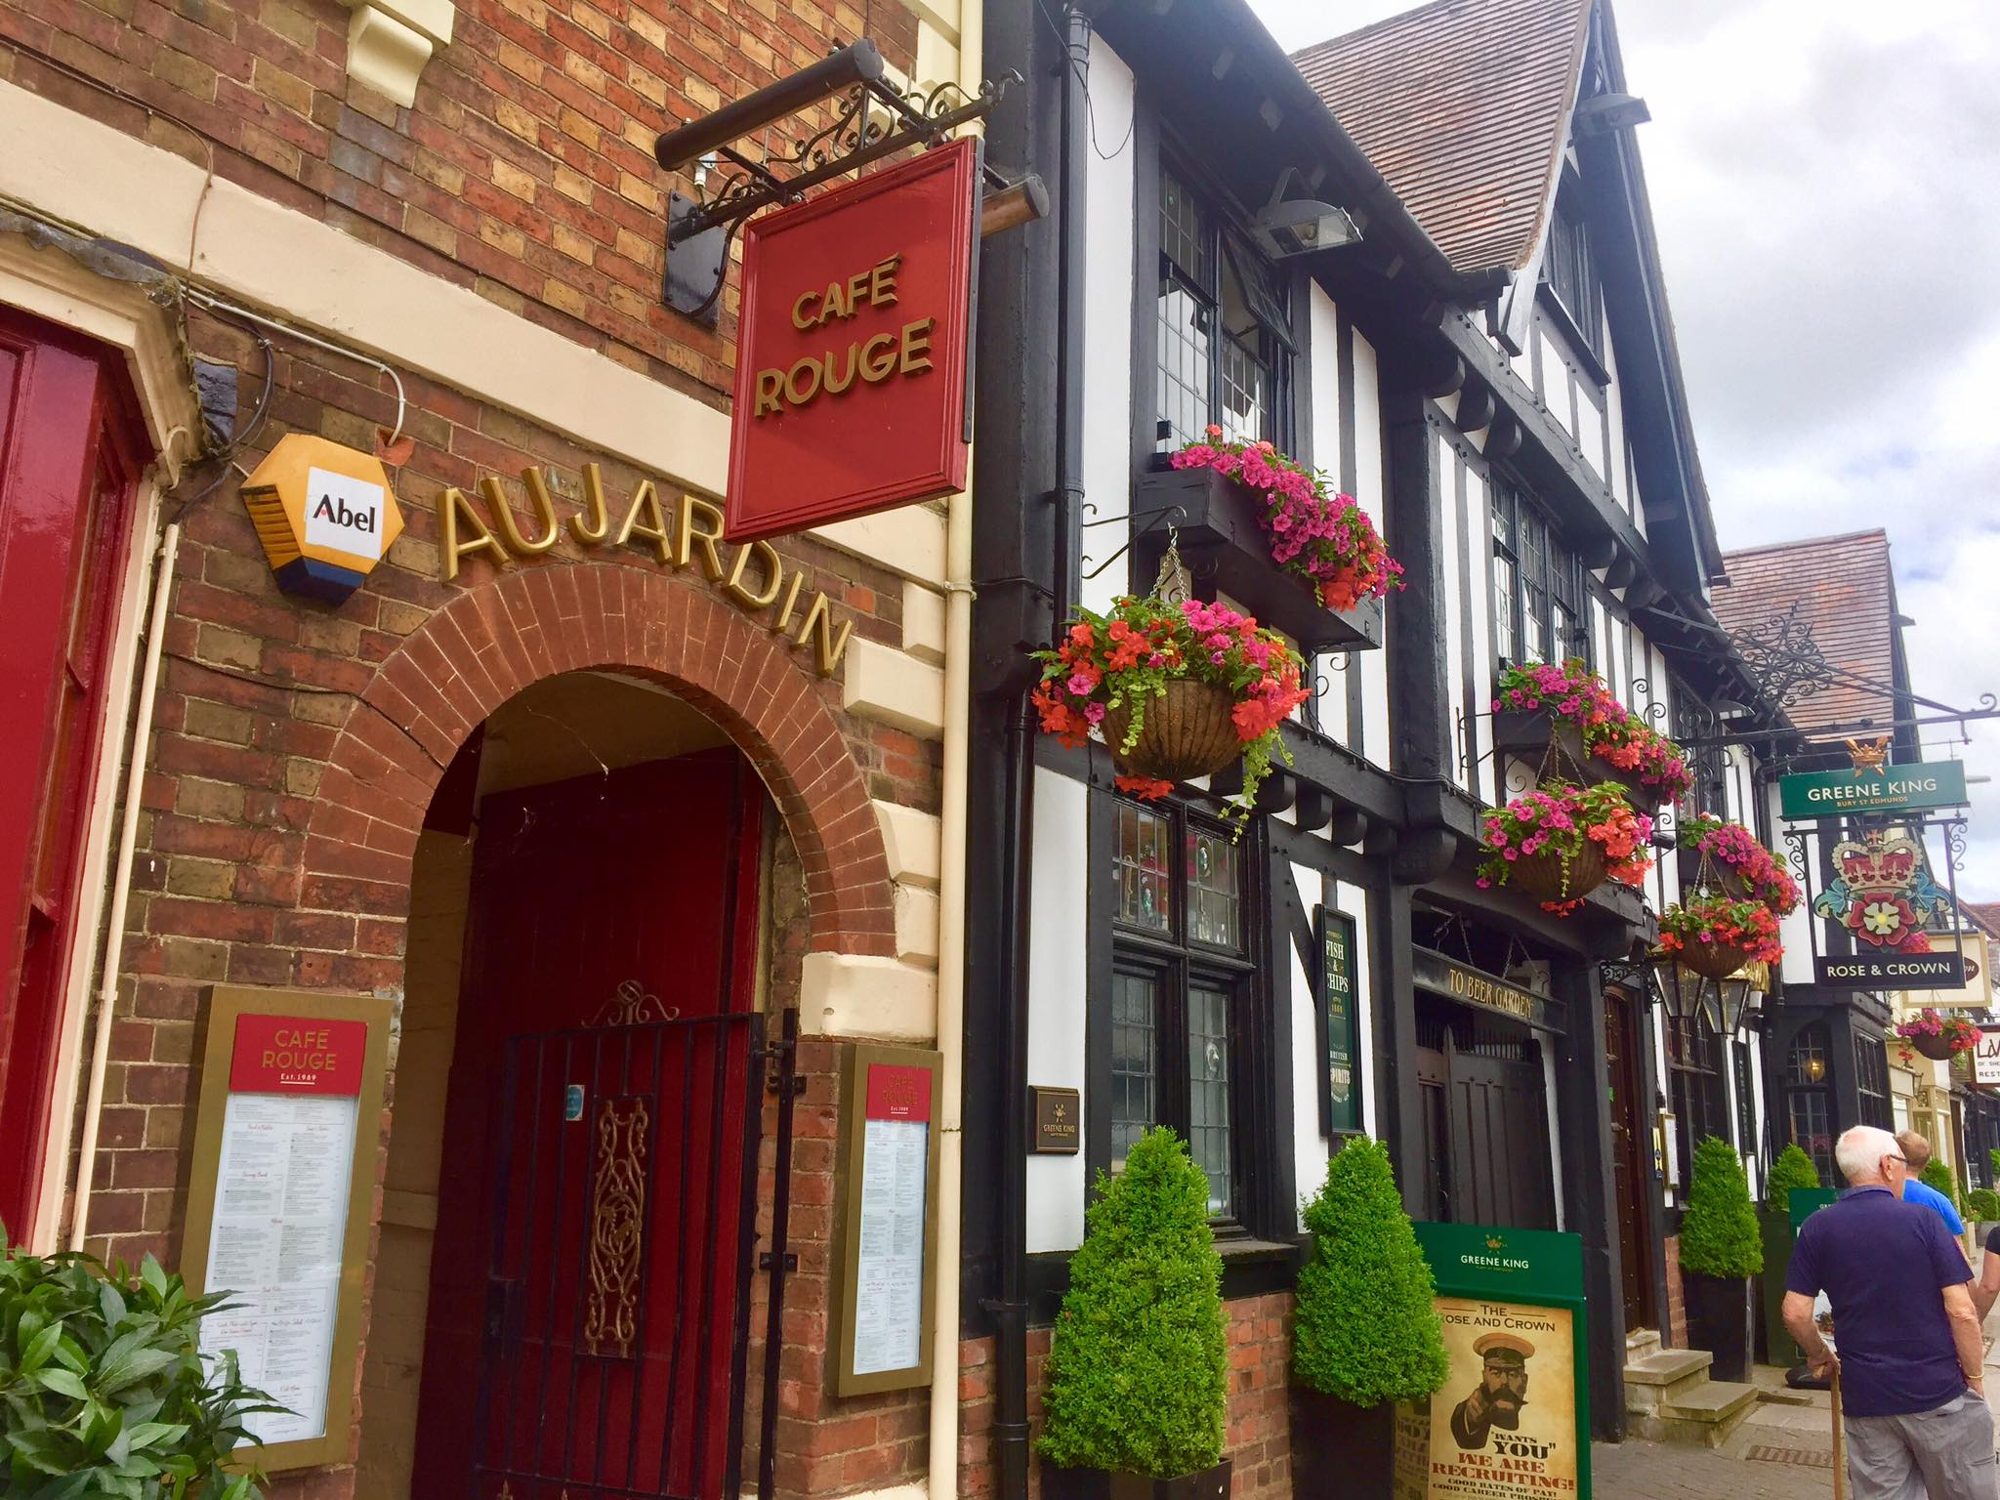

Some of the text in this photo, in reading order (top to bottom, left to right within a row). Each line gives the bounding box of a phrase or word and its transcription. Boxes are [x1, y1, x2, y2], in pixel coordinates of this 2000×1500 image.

[791, 251, 903, 329] CAFÉ
[754, 317, 936, 418] ROUGE
[312, 493, 376, 533] Abel
[1808, 778, 1937, 801] GREENE KING
[1870, 796, 1909, 805] EDMUNDS
[1326, 940, 1345, 960] FISH
[1333, 959, 1338, 972] &
[1827, 965, 1866, 977] ROSE
[1871, 964, 1882, 976] &
[1887, 962, 1951, 975] CROWN
[1449, 968, 1532, 1018] TO BEER GARDEN
[274, 1029, 331, 1049] CAFÉ
[261, 1050, 337, 1071] ROUGE
[1460, 1254, 1500, 1267] GREENE
[1503, 1258, 1529, 1269] KING
[1480, 1304, 1508, 1317] THE
[1474, 1317, 1501, 1328] AND
[1504, 1318, 1556, 1332] CROWN
[1458, 1452, 1545, 1474] WE ARE
[1431, 1462, 1575, 1491] RECRUITING!
[1432, 1483, 1460, 1491] GOOD
[1463, 1487, 1506, 1498] CAREER
[1448, 1478, 1557, 1498] GOOD RATES OF PAY!
